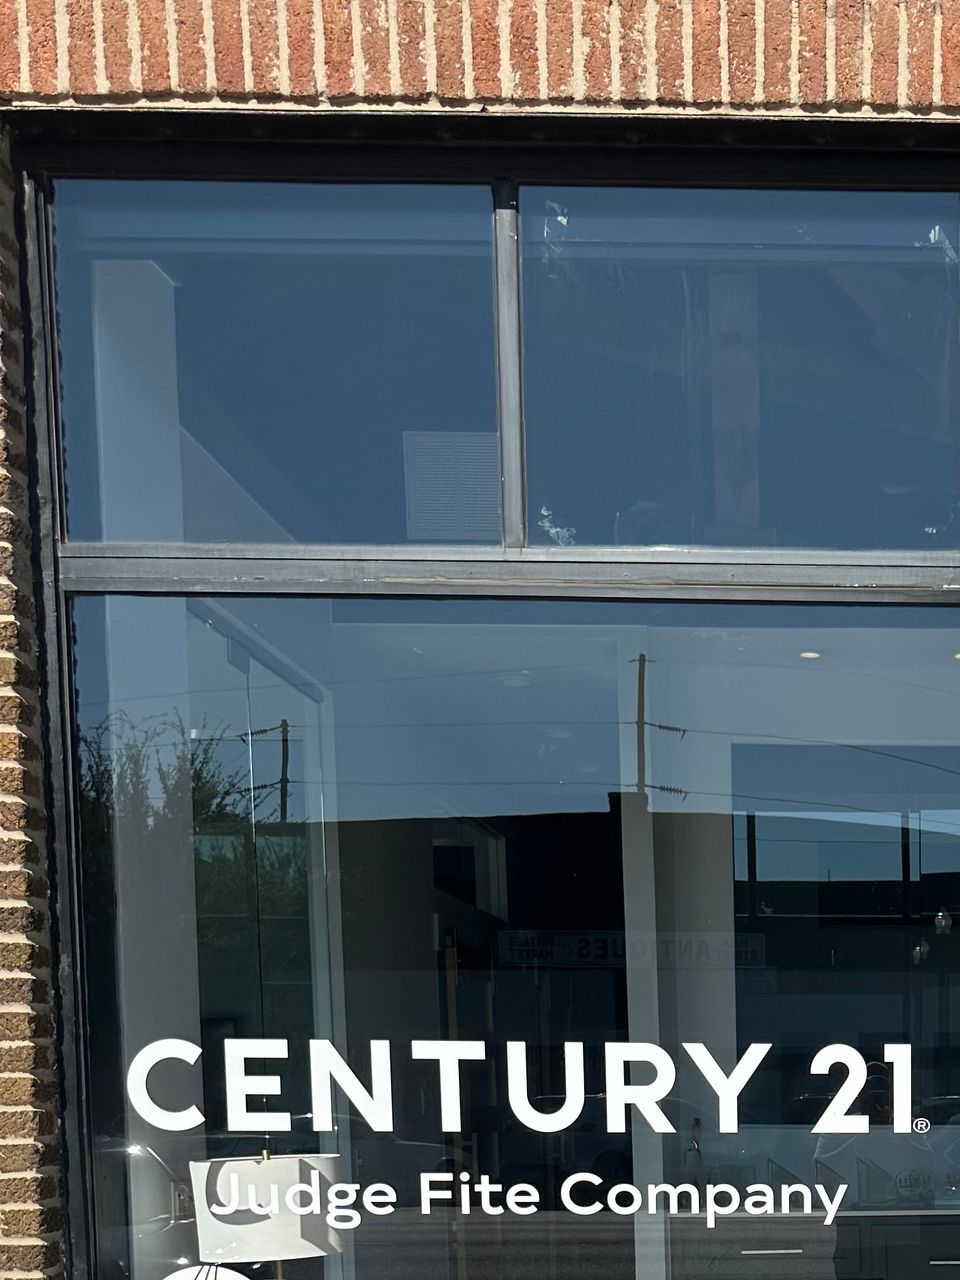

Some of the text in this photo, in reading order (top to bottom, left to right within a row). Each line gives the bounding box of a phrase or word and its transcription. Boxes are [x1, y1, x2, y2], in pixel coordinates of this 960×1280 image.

[126, 1038, 773, 1133] CENTURY
[209, 1168, 398, 1230] Judge
[420, 1171, 541, 1215] Fite
[560, 1171, 849, 1230] Company
